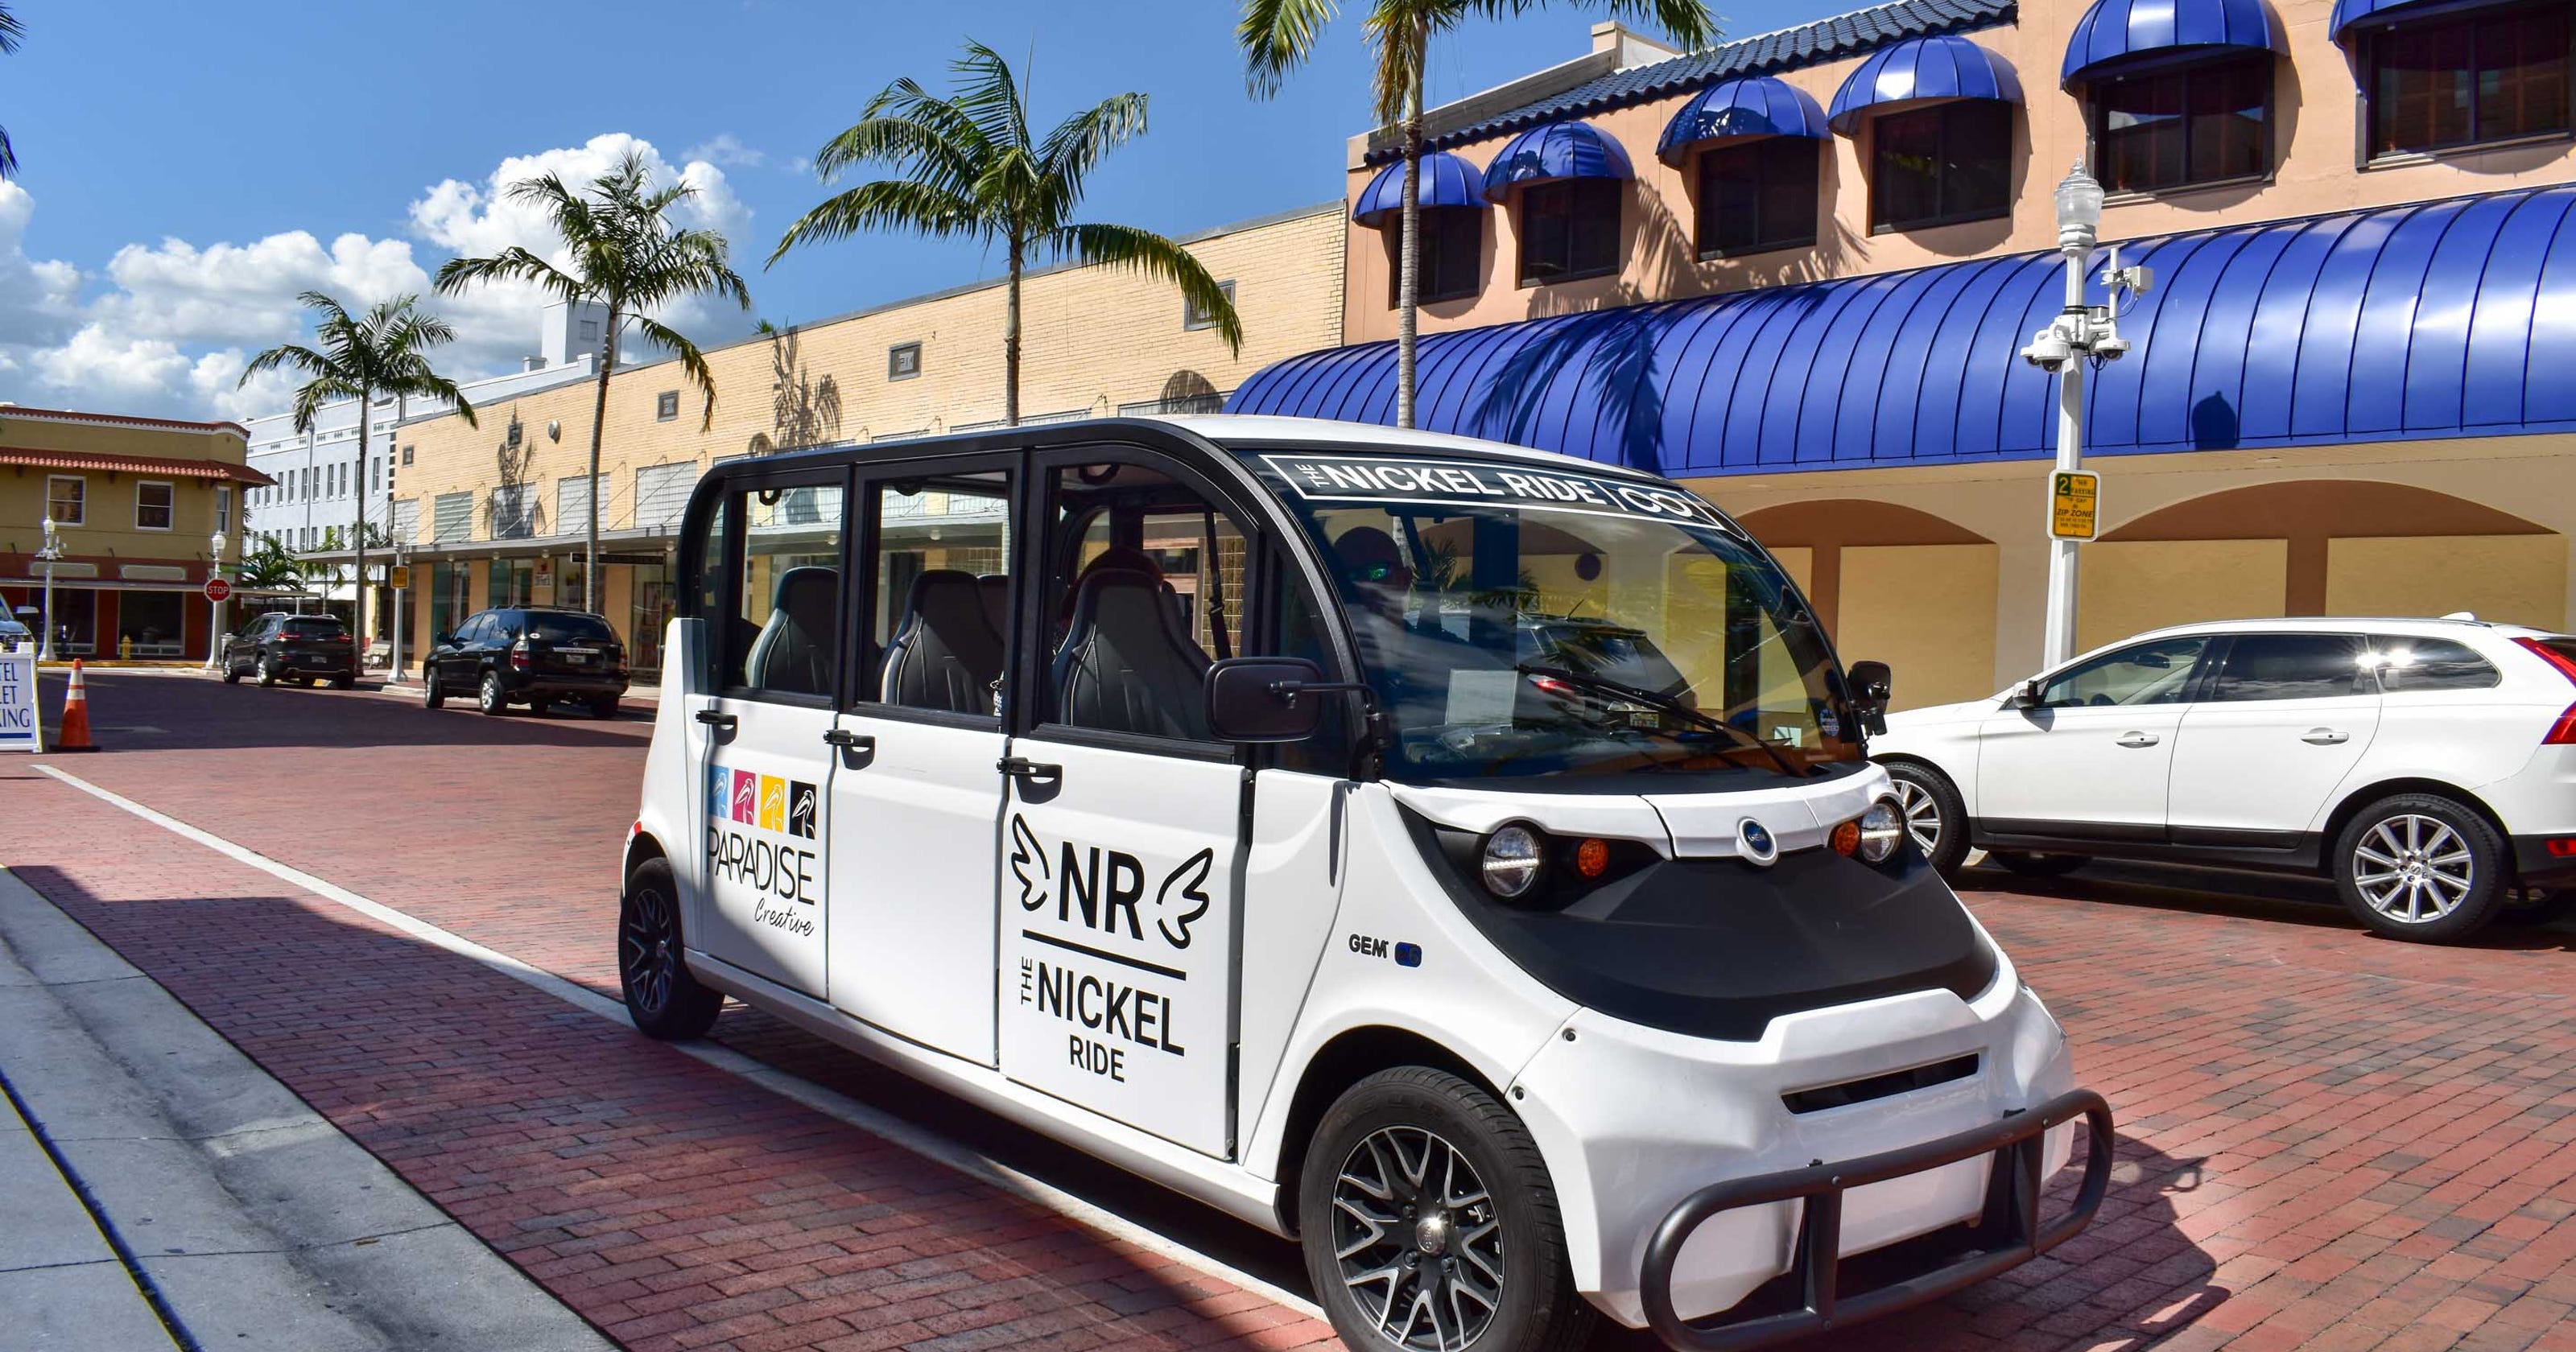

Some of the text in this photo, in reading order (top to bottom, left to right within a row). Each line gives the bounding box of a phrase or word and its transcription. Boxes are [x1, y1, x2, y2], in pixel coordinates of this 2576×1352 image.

[1295, 464, 1331, 488] THE
[1319, 464, 1505, 496] NICKEL
[1496, 472, 1608, 505] RIDE
[2058, 476, 2069, 493] 2
[2070, 509, 2094, 517] ZONE
[208, 586, 229, 595] STOP
[0, 686, 18, 704] ET
[0, 708, 30, 728] ING
[707, 825, 815, 905] PARADISE
[1059, 841, 1145, 941] NR
[754, 897, 815, 937] Creative
[1348, 934, 1387, 959] GEM
[1021, 956, 1185, 1057] THE NICKEL
[1069, 1034, 1125, 1082] RIDE
